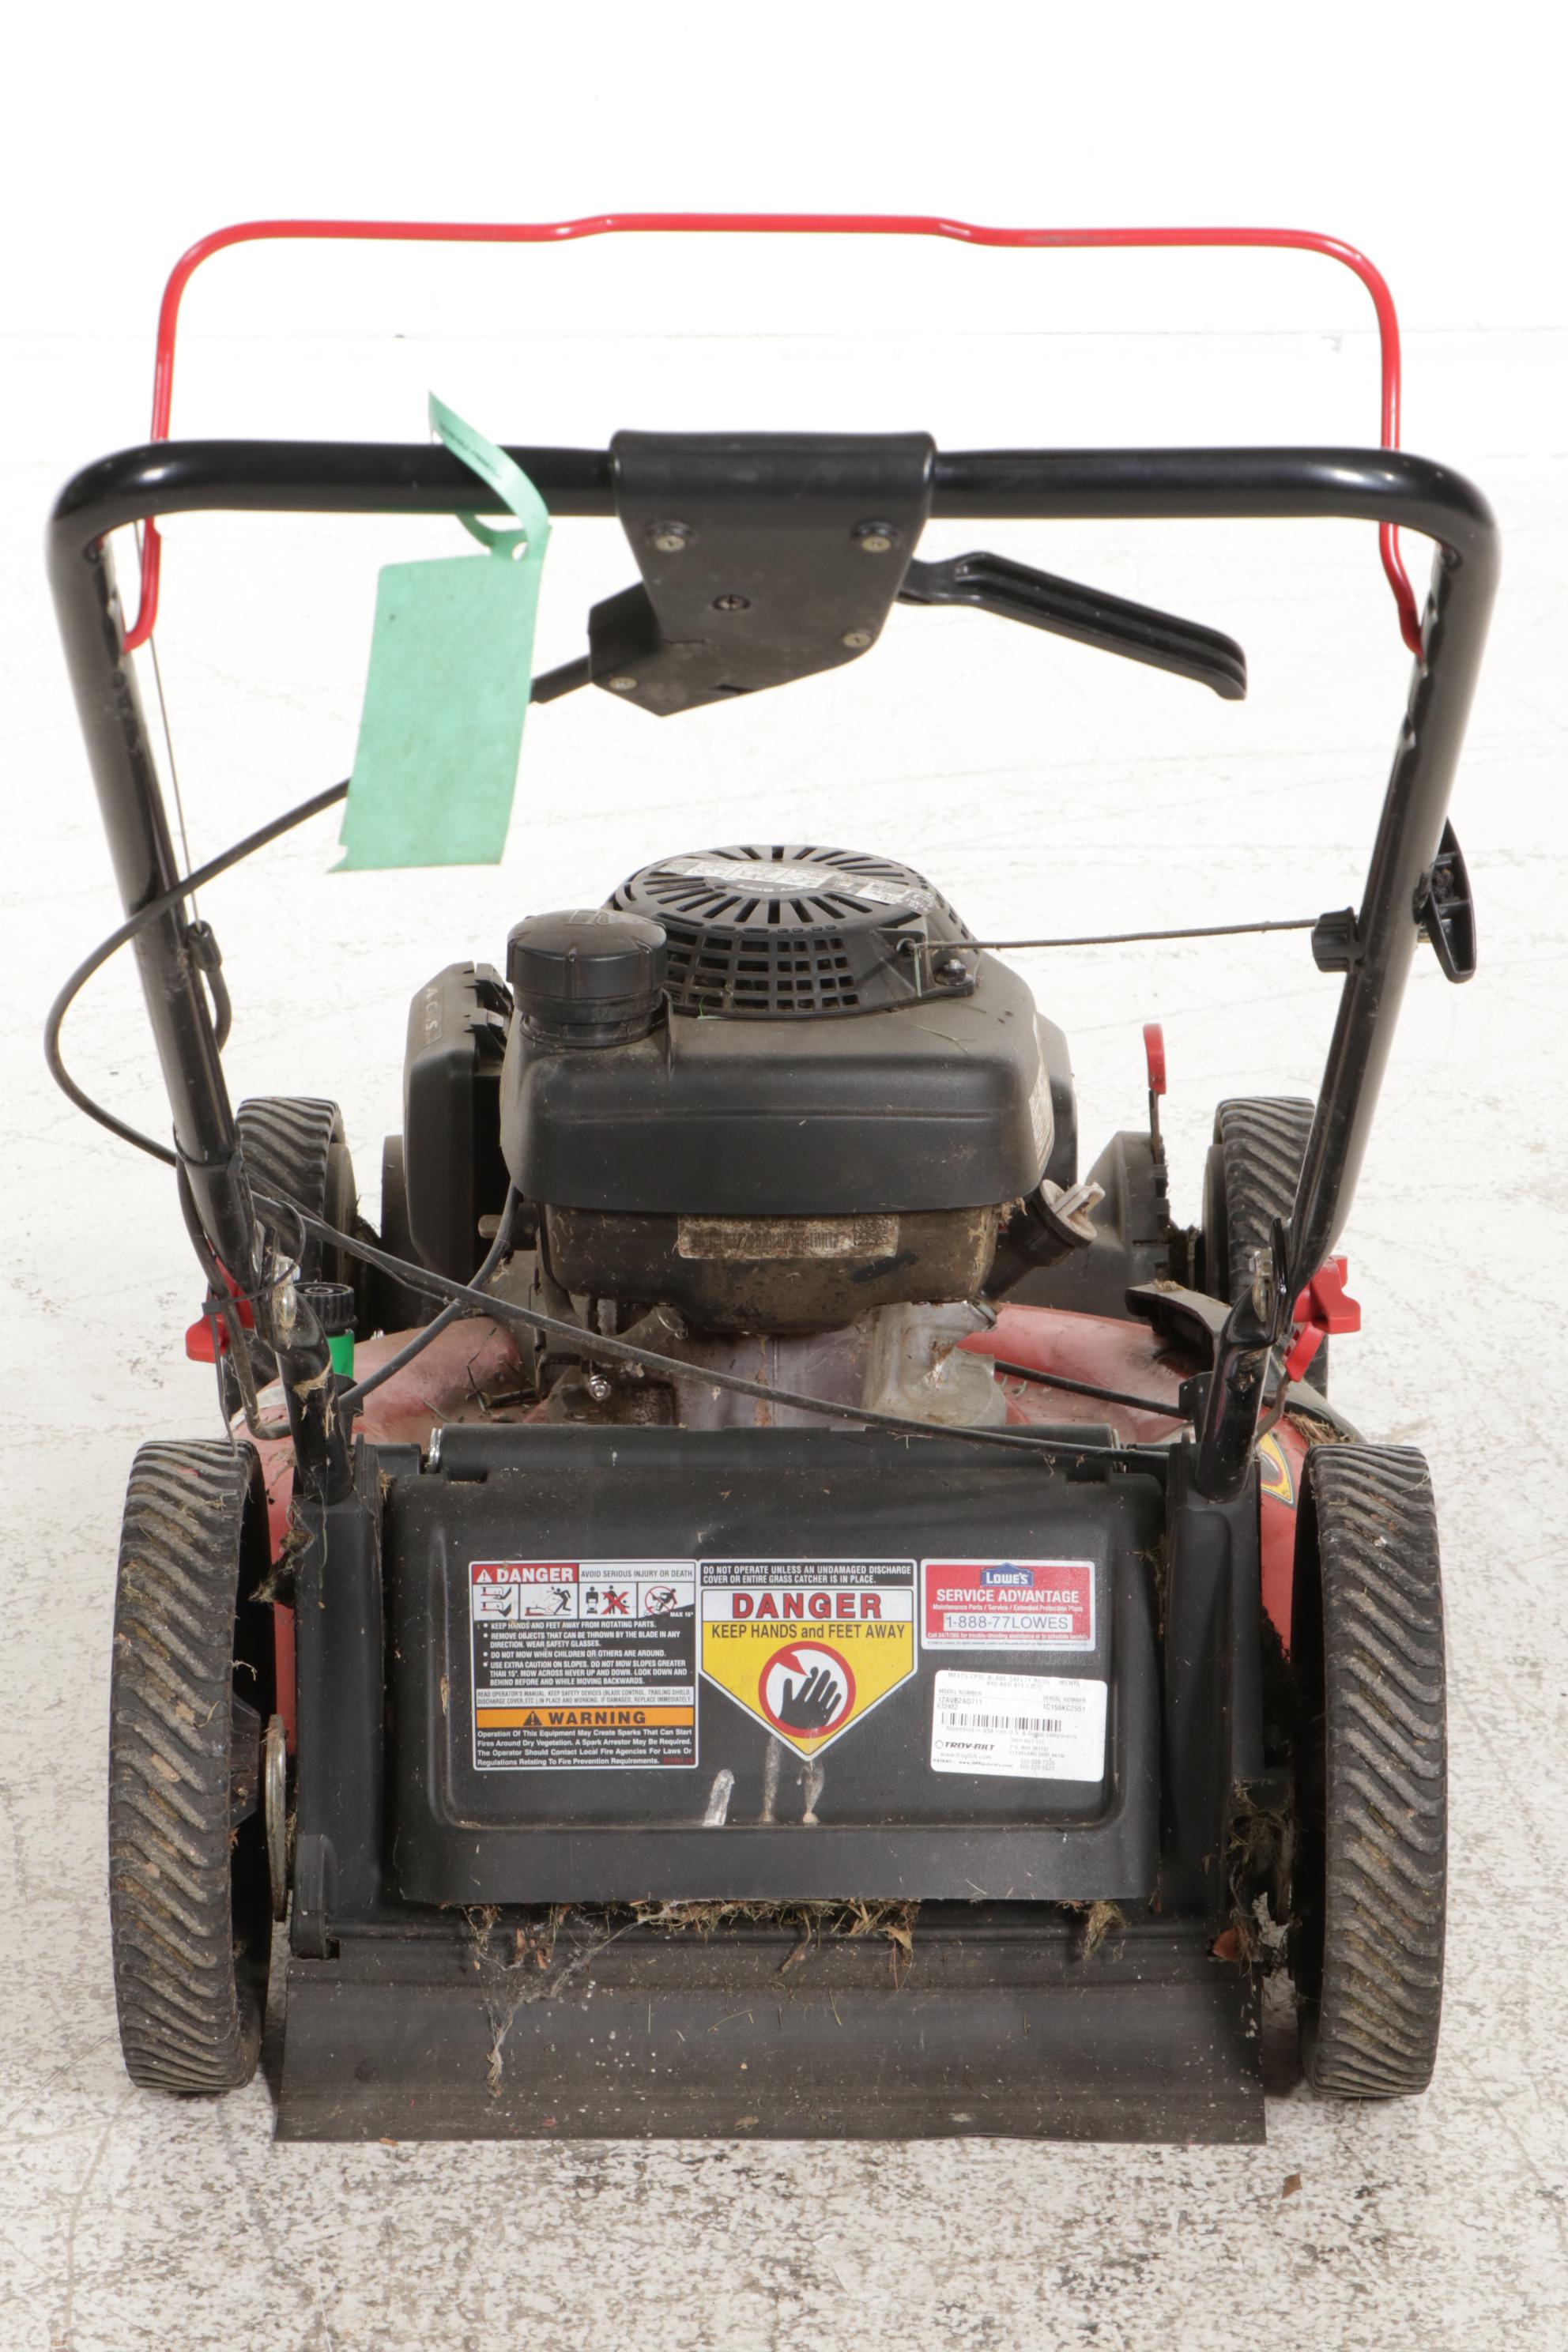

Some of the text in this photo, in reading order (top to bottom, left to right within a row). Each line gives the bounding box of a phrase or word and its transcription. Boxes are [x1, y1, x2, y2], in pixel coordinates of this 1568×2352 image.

[496, 1567, 575, 1583] DANGER
[703, 1566, 911, 1574] DO NOT OPERATE UNLESS AN UNDAMAGED DISCHARGE
[703, 1574, 876, 1584] COVER OR ENTIRE GRASS CATCHER IS IN PLACE.
[986, 1571, 1028, 1585] LOWE'S
[937, 1589, 1080, 1603] SERVICE ADVANTAGE
[732, 1592, 882, 1619] DANGER
[947, 1615, 1069, 1629] 1-888-77LOWES
[712, 1625, 905, 1638] KEEP HANDS and FEET AWAY
[548, 1711, 646, 1725] WARNING
[539, 1729, 575, 1738] Equipment
[944, 1741, 995, 1751] TROY-BILT
[611, 1757, 659, 1766] Requirements.
